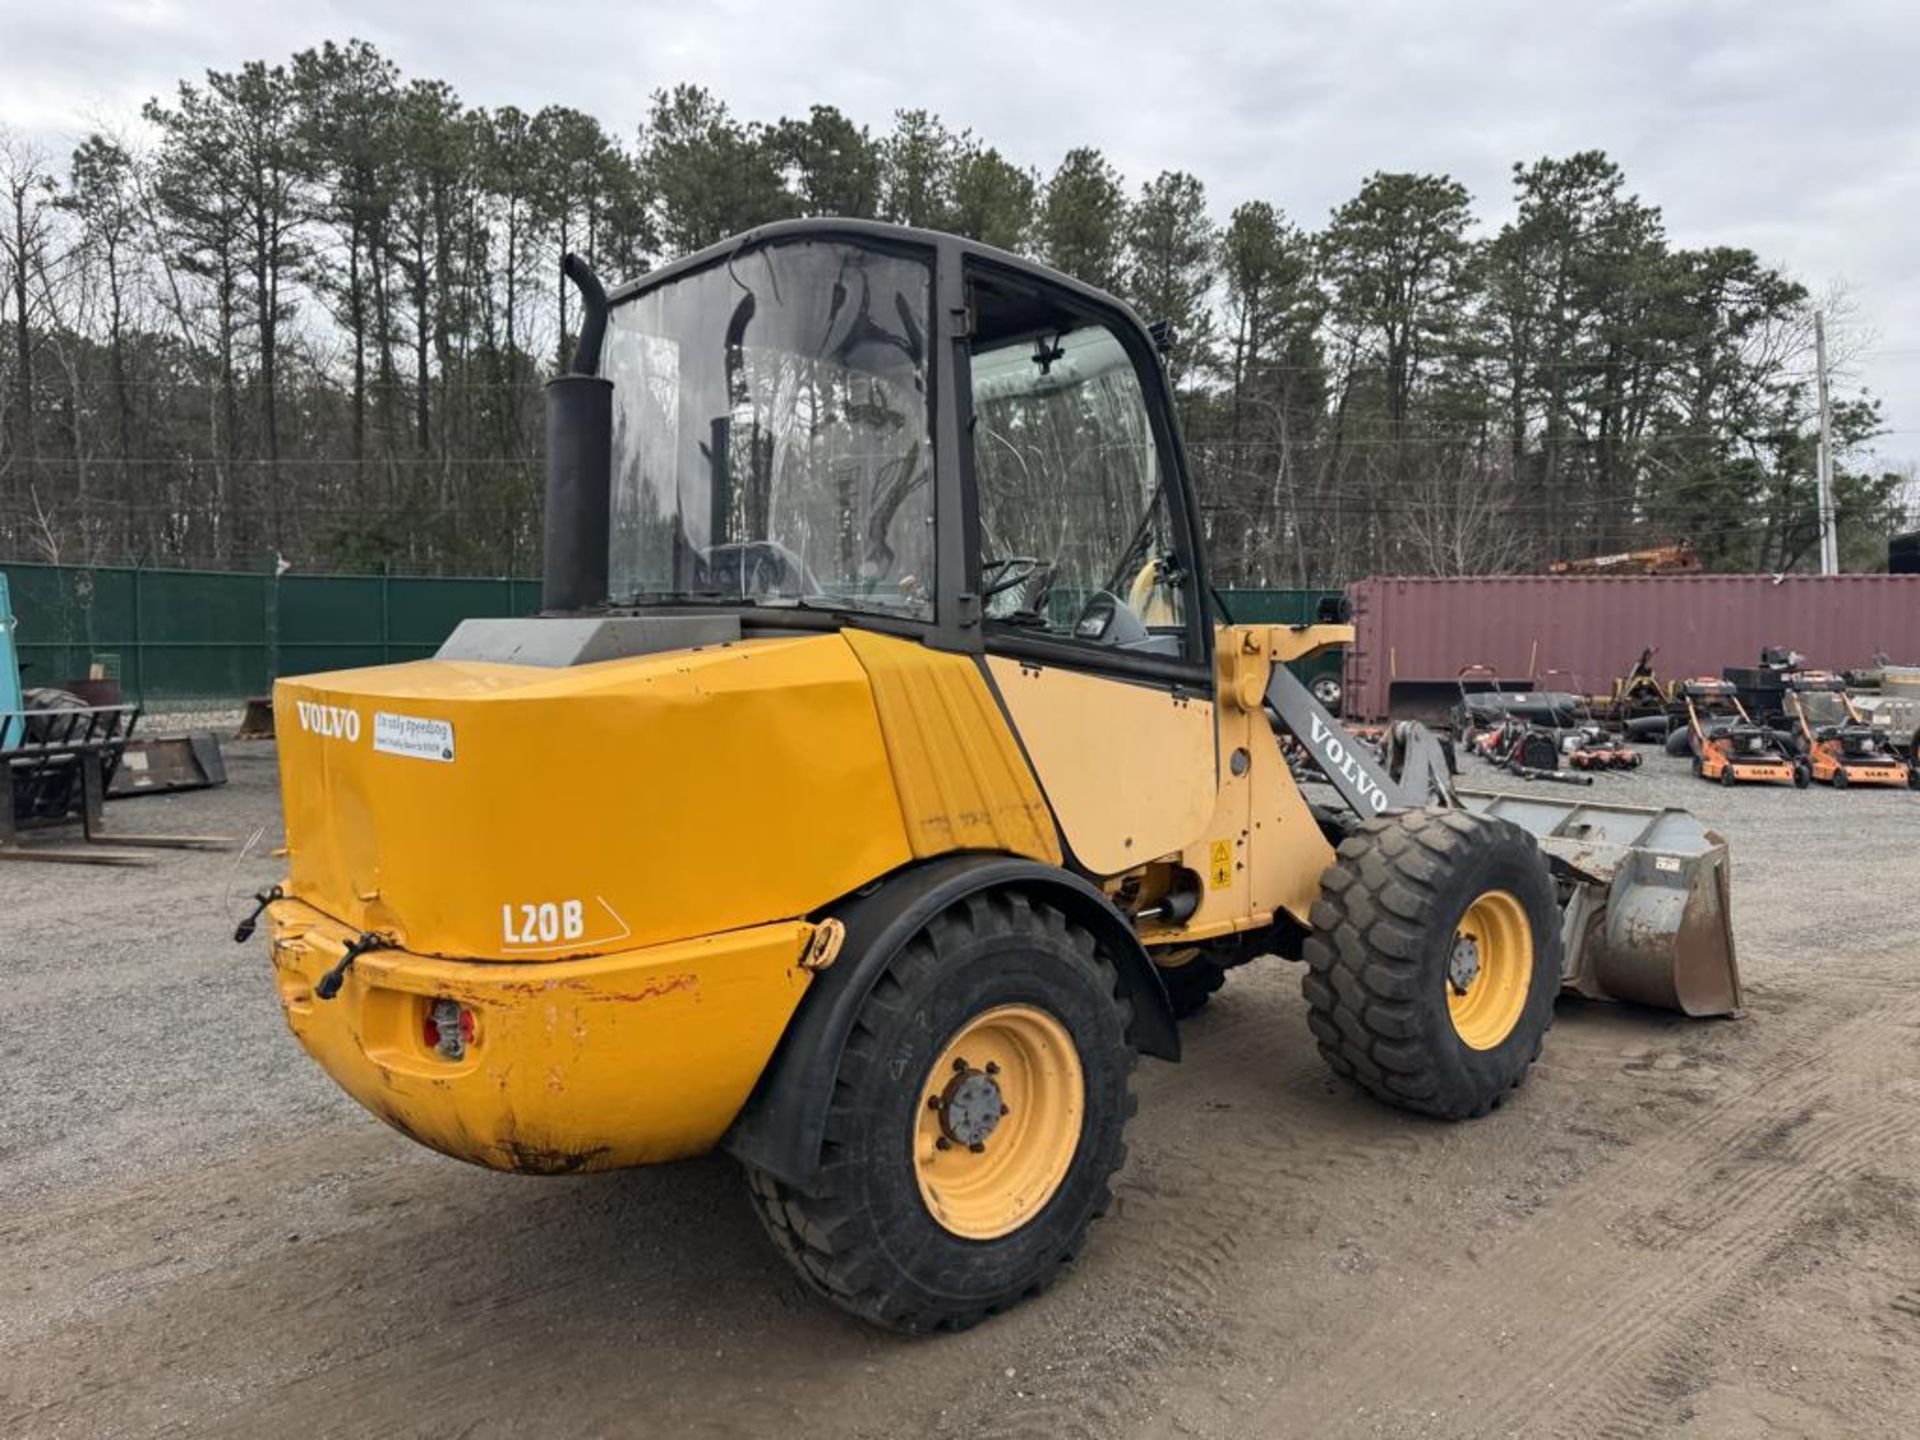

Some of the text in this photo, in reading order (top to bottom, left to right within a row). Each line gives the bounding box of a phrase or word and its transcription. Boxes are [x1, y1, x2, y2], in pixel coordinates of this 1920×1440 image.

[296, 701, 360, 742] VOLVO
[406, 719, 448, 740] speeding
[1311, 712, 1388, 812] VOLVO
[503, 899, 584, 943] L20B
